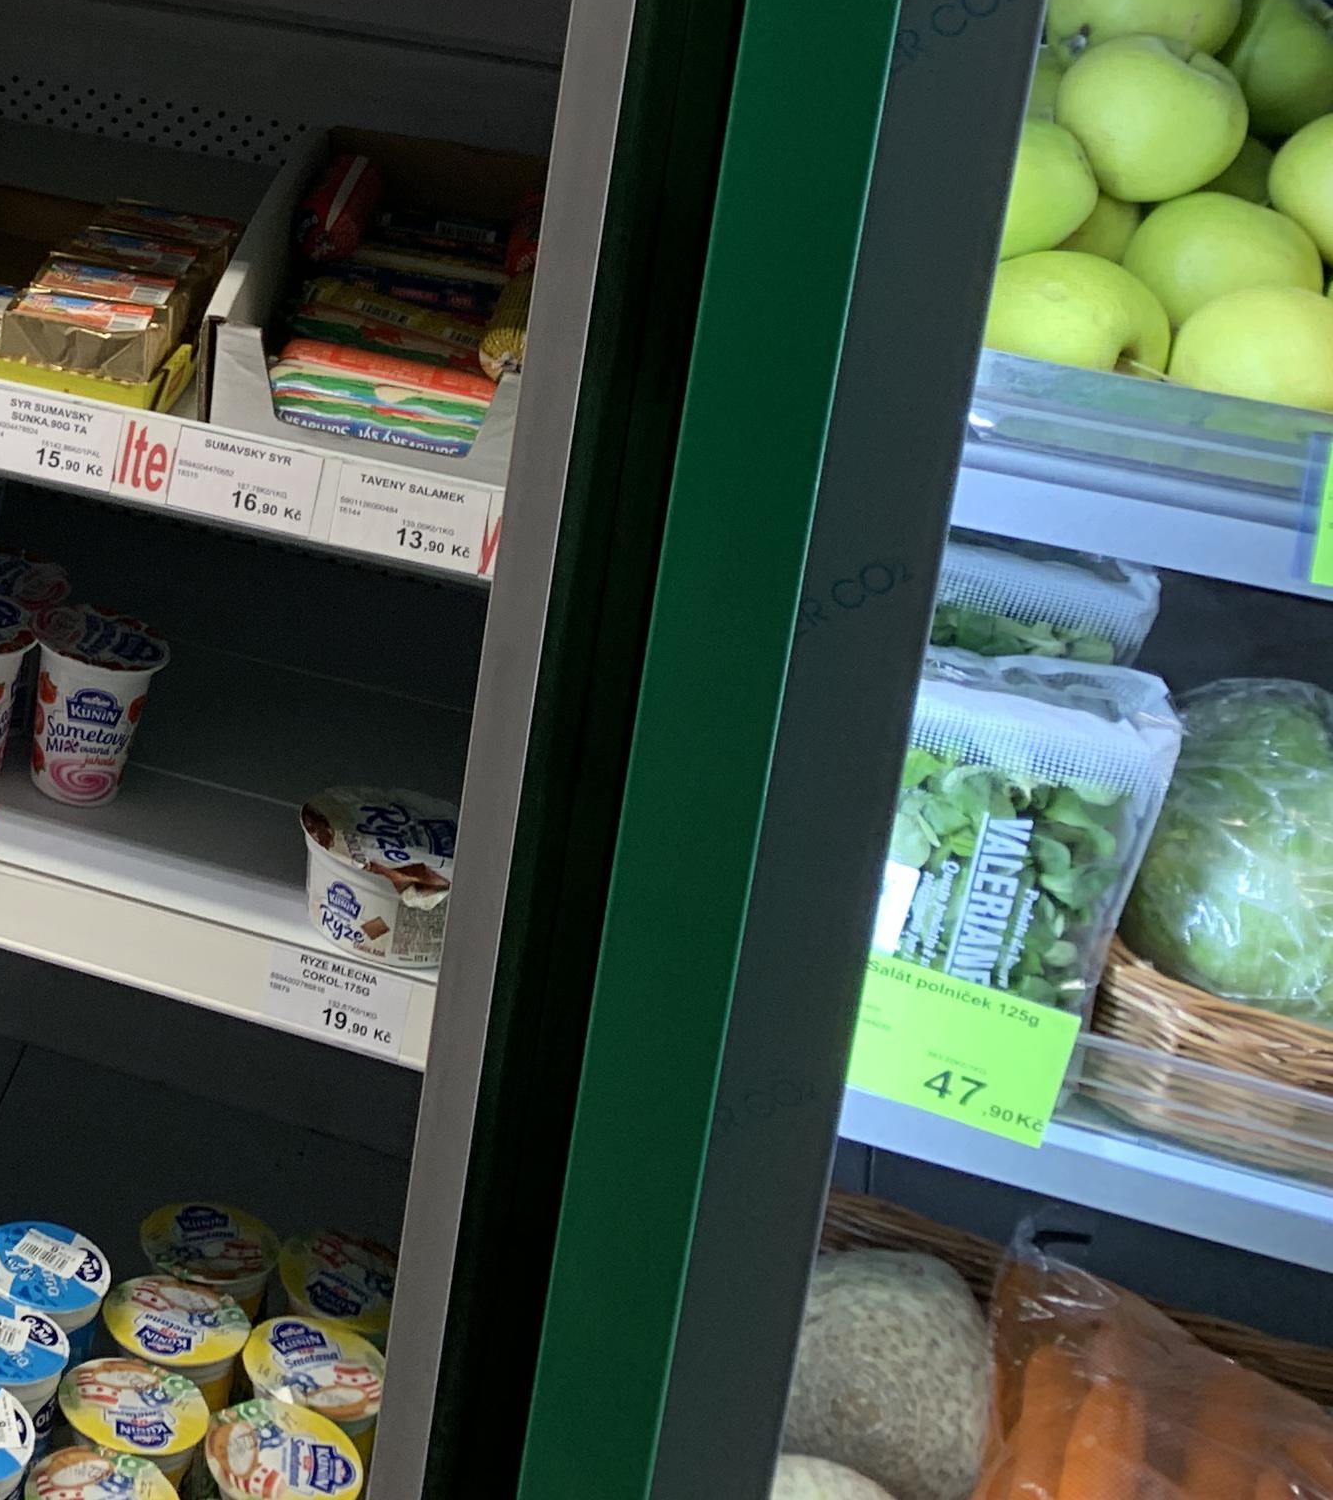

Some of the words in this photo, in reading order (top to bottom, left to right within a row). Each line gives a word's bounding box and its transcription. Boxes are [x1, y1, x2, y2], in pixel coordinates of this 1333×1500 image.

[10, 398, 31, 411] SYR
[34, 403, 94, 423] SUMAVSKY
[11, 412, 64, 433] SUNKA.90G
[67, 422, 88, 435] TA
[35, 448, 81, 473] 15,90
[86, 464, 103, 478] Kč
[205, 439, 265, 461] SUMAVSKY
[269, 453, 292, 467] SYR
[360, 473, 405, 494] TAVENY
[408, 483, 466, 504] SALAMEK
[231, 489, 278, 516] 16,90
[284, 506, 302, 522] Kč
[396, 527, 445, 556] 13,90
[451, 543, 470, 559] Kč
[299, 954, 331, 972] RYZE
[332, 963, 379, 986] MLECNA
[301, 968, 371, 997] COKOL.175G
[867, 957, 915, 988] Salát
[915, 975, 994, 1014] polníček
[998, 999, 1040, 1029] 125g
[321, 1007, 369, 1037] 19,90
[373, 1028, 392, 1044] Kč
[922, 1069, 1014, 1125] 47,90
[1015, 1107, 1045, 1135] Kč
